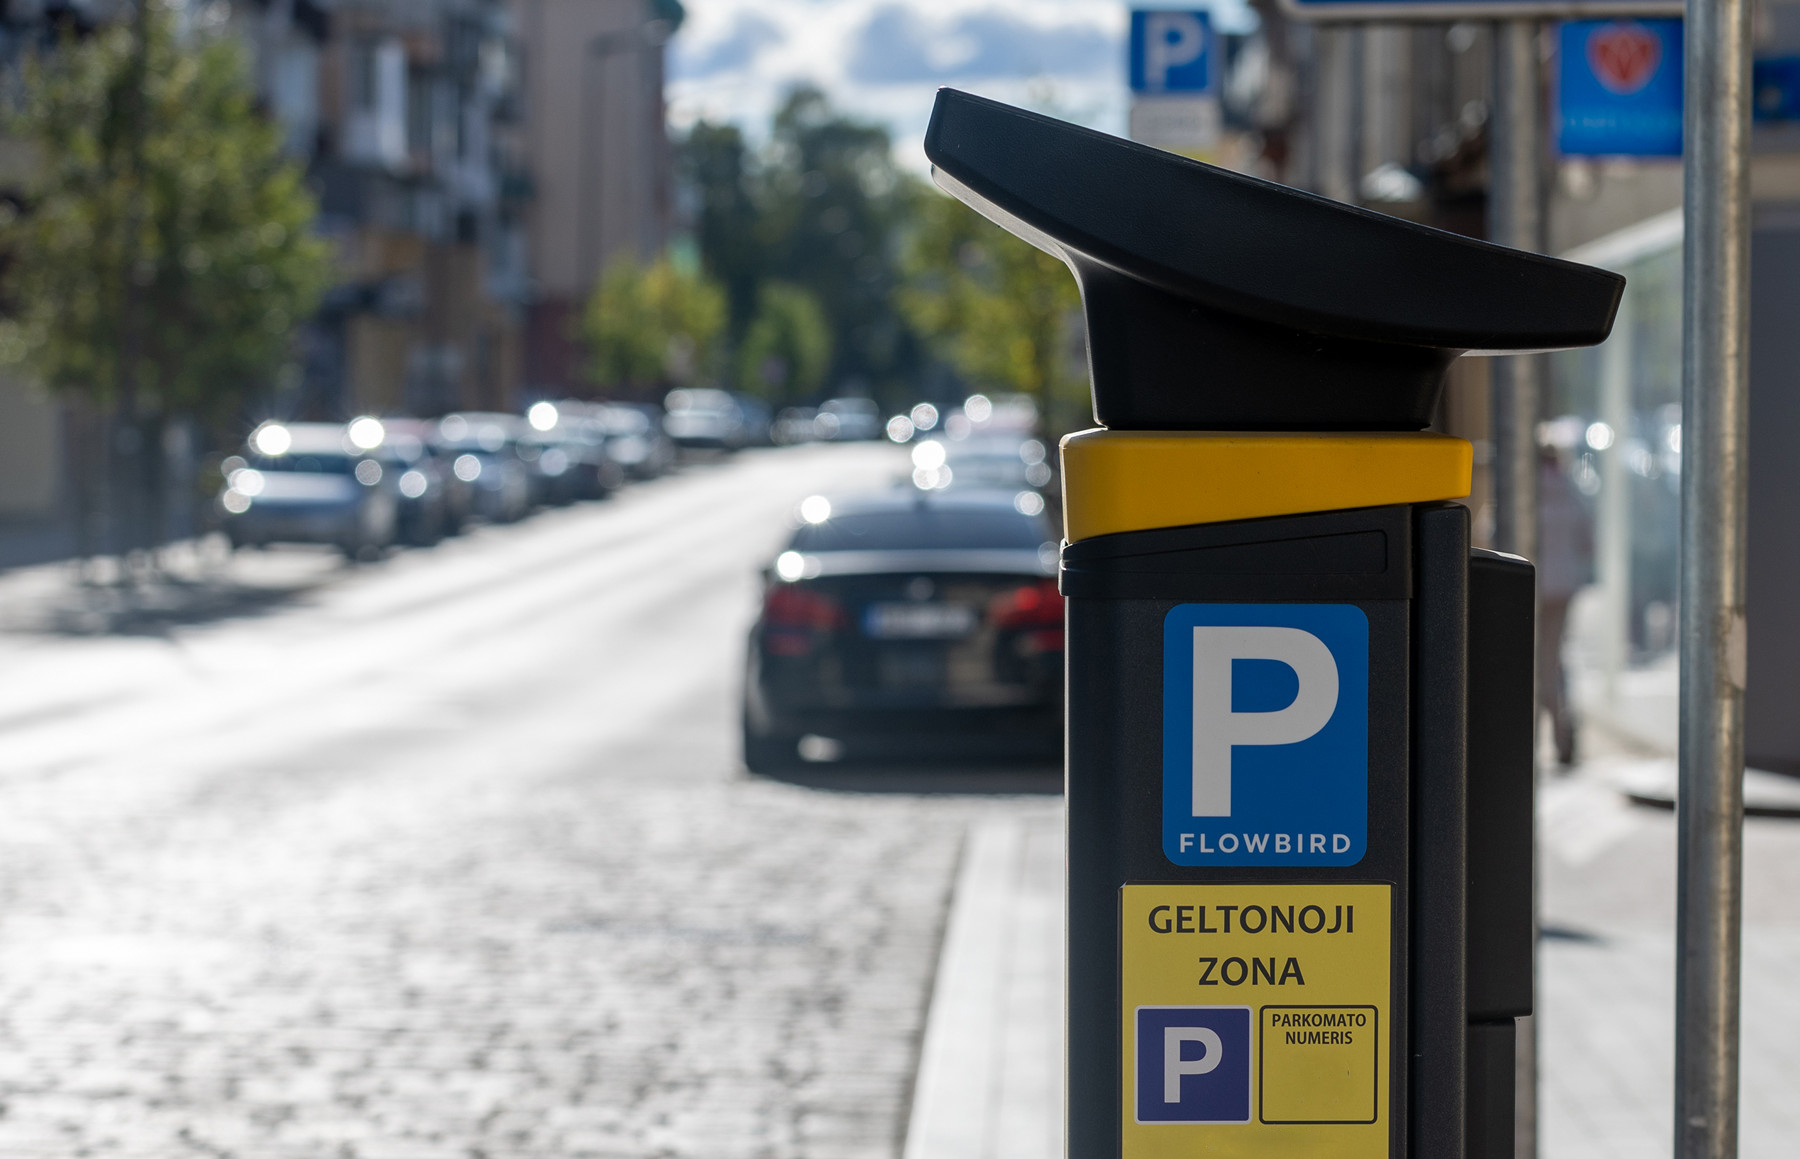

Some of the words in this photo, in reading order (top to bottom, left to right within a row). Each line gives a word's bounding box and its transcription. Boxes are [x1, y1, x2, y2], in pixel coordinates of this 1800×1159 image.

[1145, 12, 1202, 84] P
[1192, 626, 1339, 817] P
[1179, 833, 1351, 854] FLOWBIRD
[1148, 904, 1354, 934] GELTONOJI
[1198, 956, 1306, 987] ZONA
[1272, 1013, 1367, 1028] PARKOMATO
[1285, 1030, 1353, 1045] NUMERIS
[1164, 1026, 1223, 1104] P
